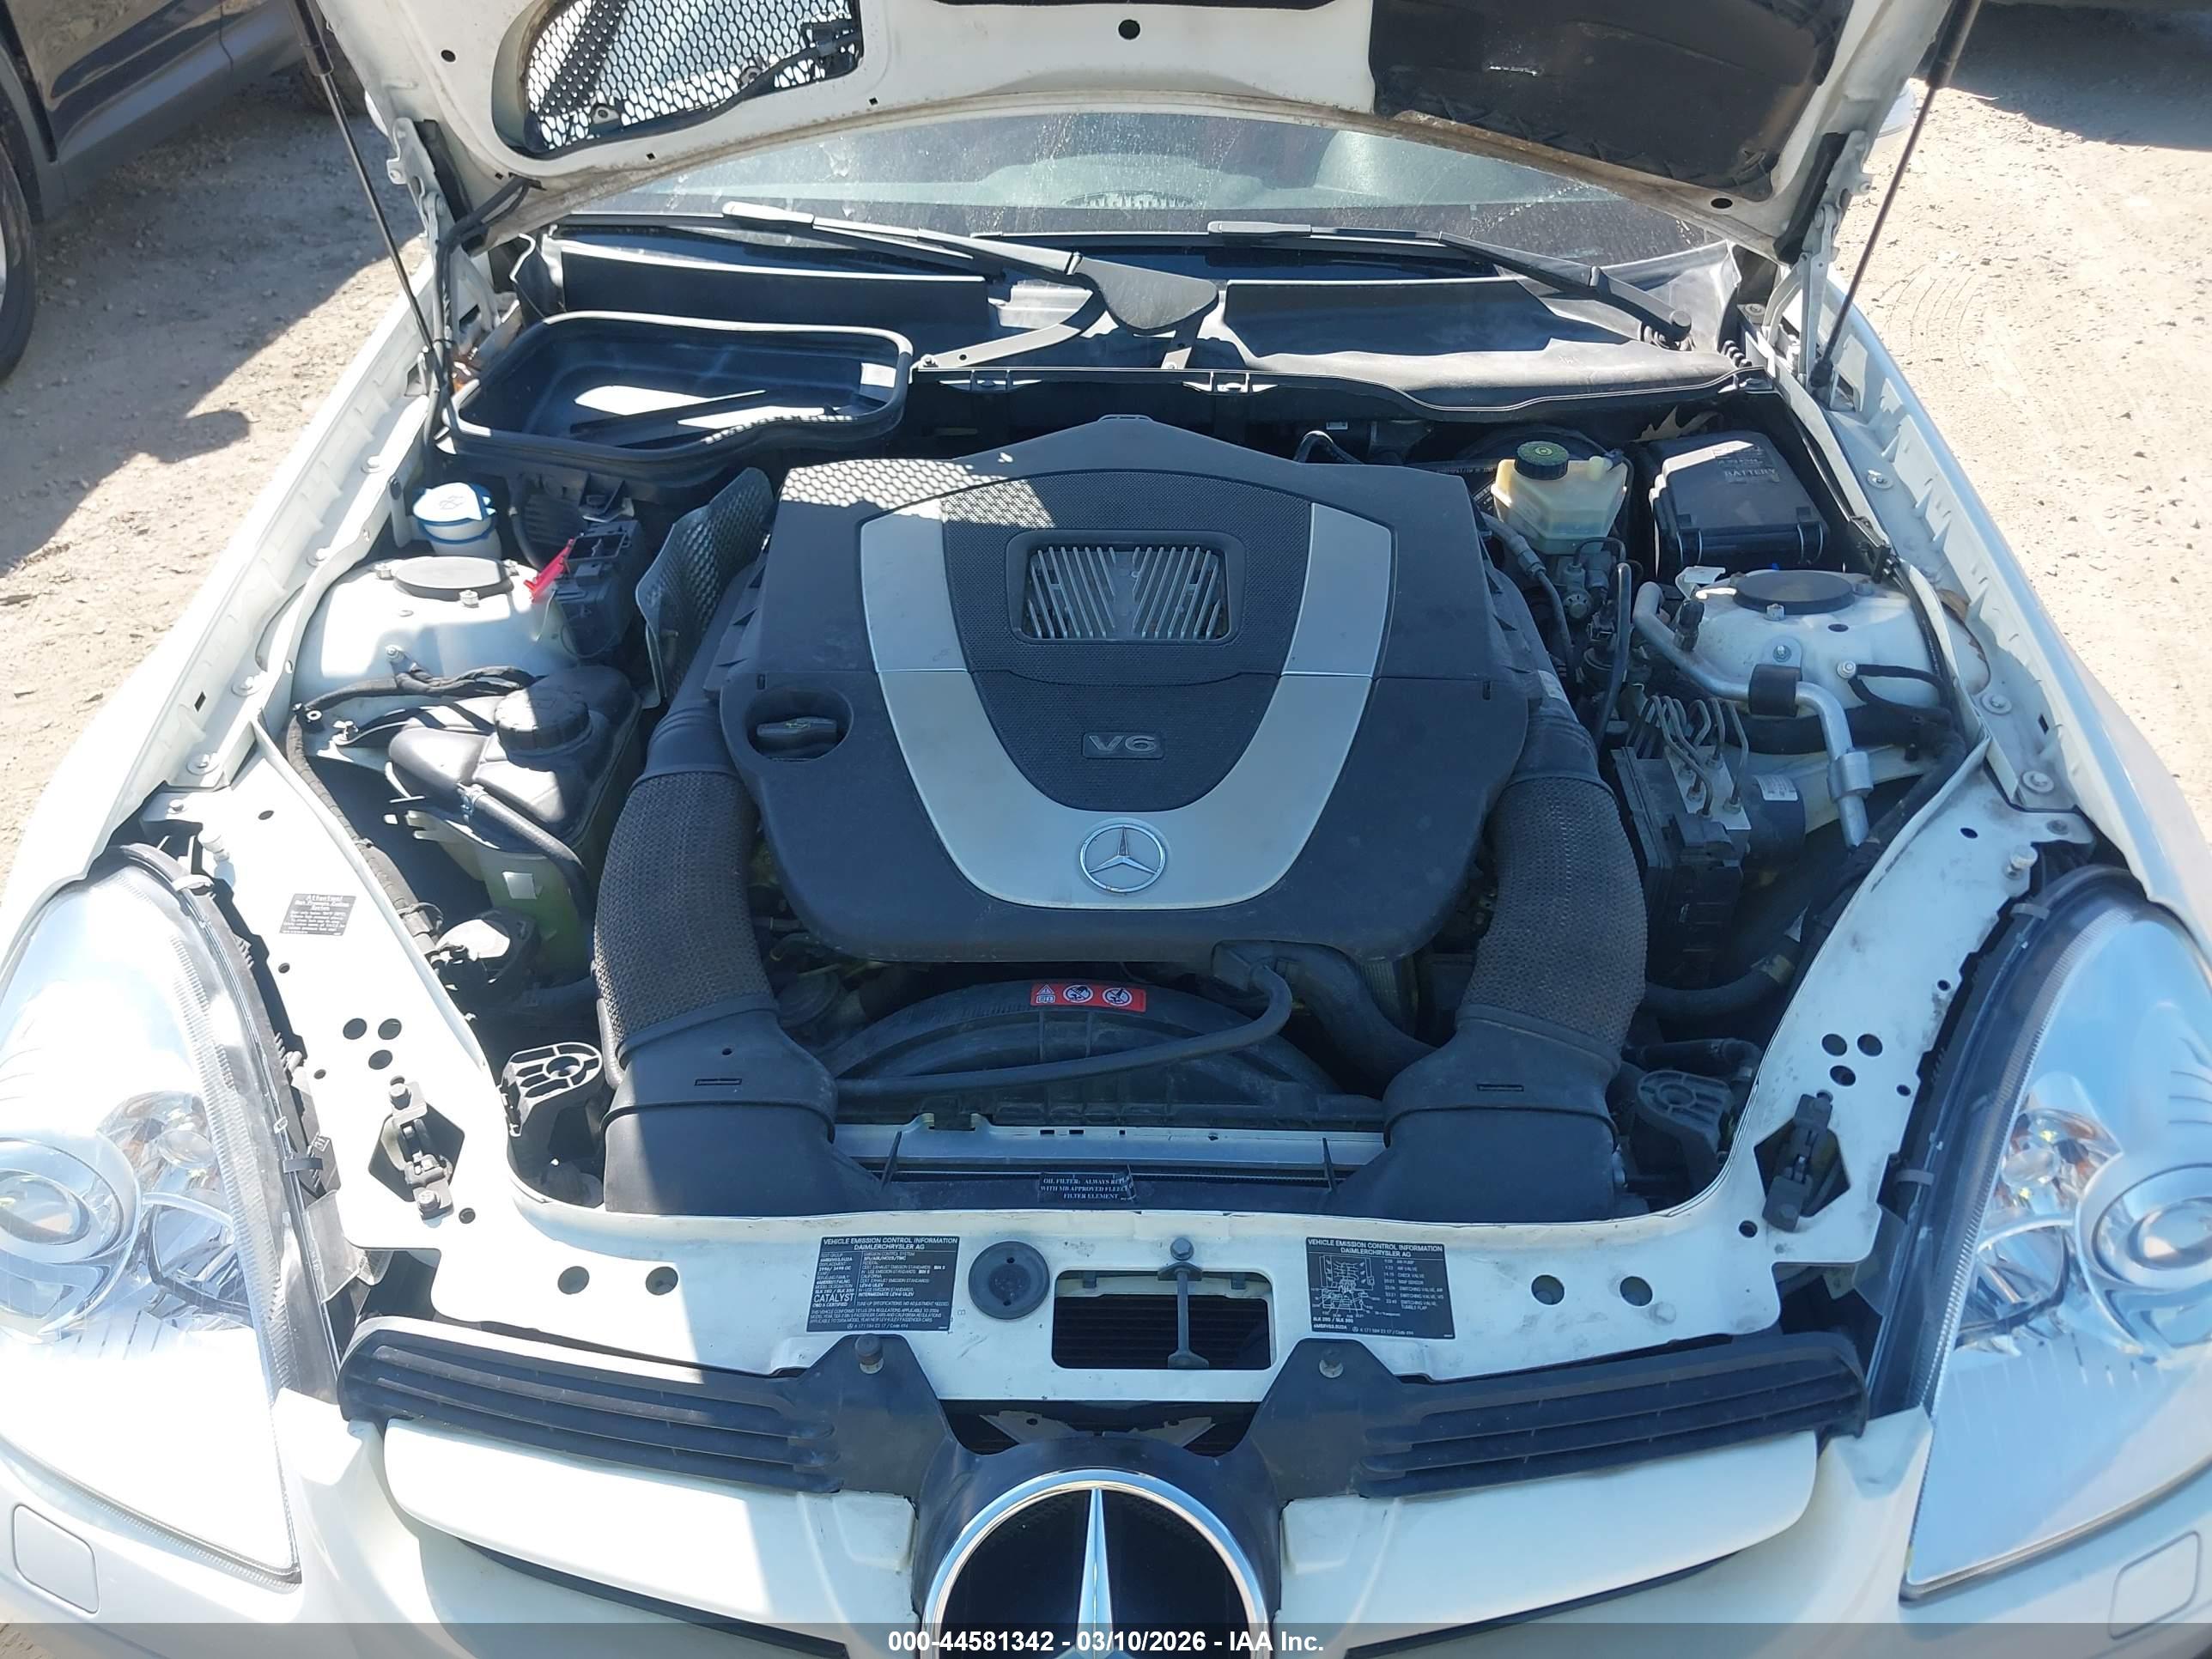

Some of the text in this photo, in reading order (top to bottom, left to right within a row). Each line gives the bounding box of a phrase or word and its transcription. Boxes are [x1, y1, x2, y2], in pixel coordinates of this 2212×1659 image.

[1724, 468, 1775, 477] BATTERY
[1089, 735, 1155, 751] V6
[1336, 1240, 1366, 1248] EMISSION
[1340, 1247, 1401, 1256] DAIMLERCHRYSLER
[814, 1293, 855, 1302] CATALYST
